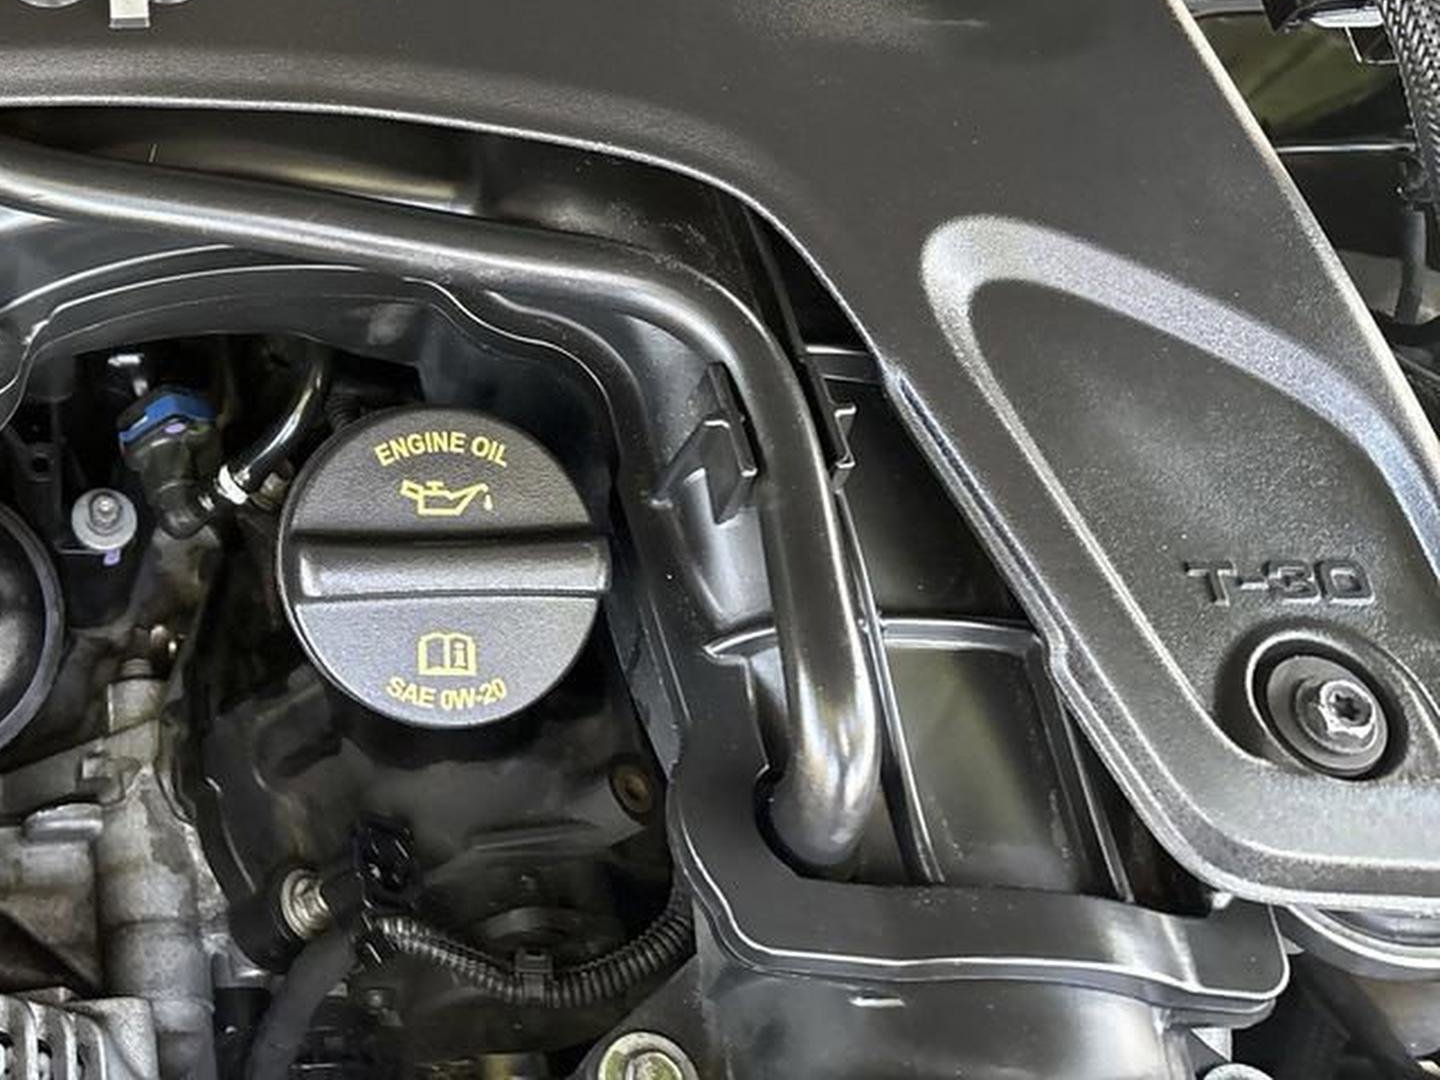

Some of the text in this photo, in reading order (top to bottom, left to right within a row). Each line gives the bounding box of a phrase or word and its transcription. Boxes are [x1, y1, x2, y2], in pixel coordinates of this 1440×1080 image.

[374, 431, 508, 467] ENGINE OIL
[1183, 559, 1376, 607] T-30
[386, 677, 507, 710] SAE 0W-20
